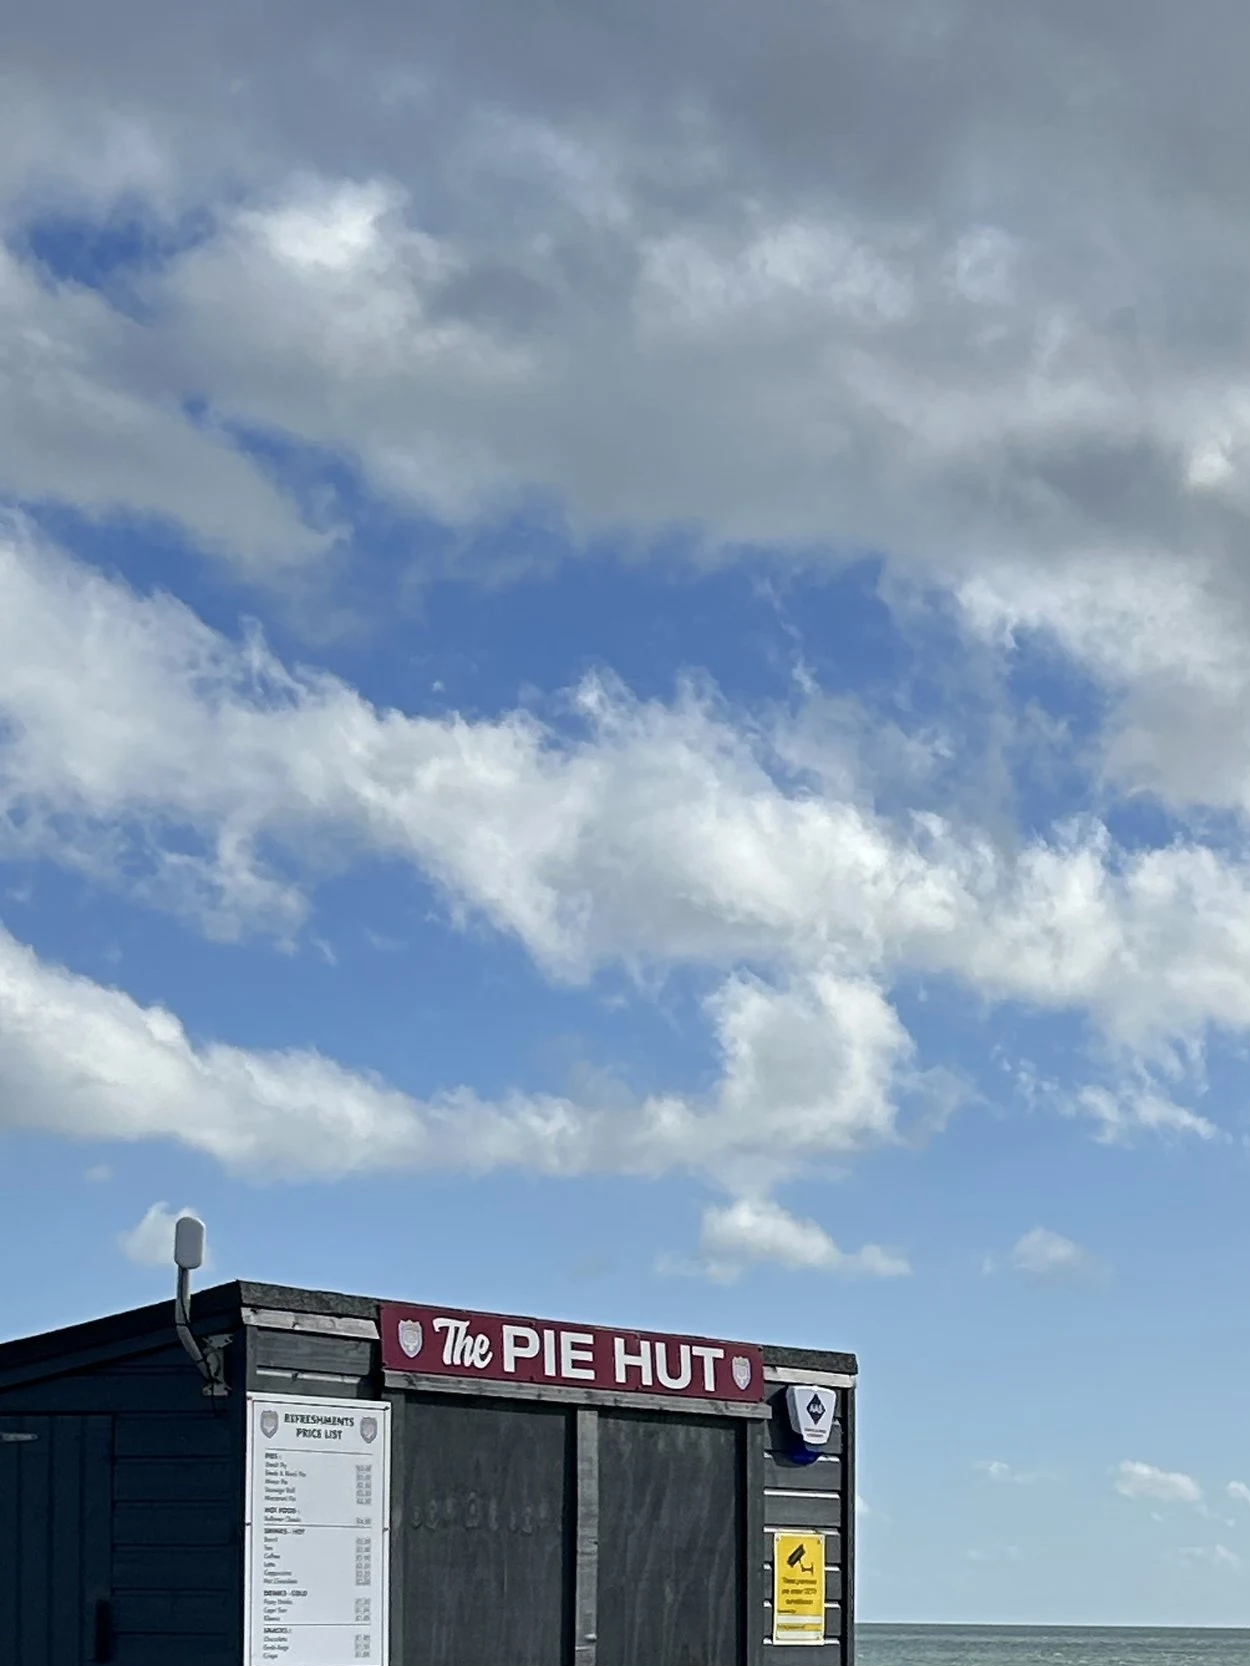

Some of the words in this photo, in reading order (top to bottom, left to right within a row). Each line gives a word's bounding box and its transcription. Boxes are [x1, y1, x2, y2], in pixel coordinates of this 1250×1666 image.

[432, 1317, 493, 1369] The
[502, 1324, 595, 1381] PIE
[614, 1337, 724, 1392] HUT
[284, 1413, 355, 1427] REFRESHMENTS
[295, 1427, 322, 1439] PRICE
[325, 1429, 343, 1440] LIST
